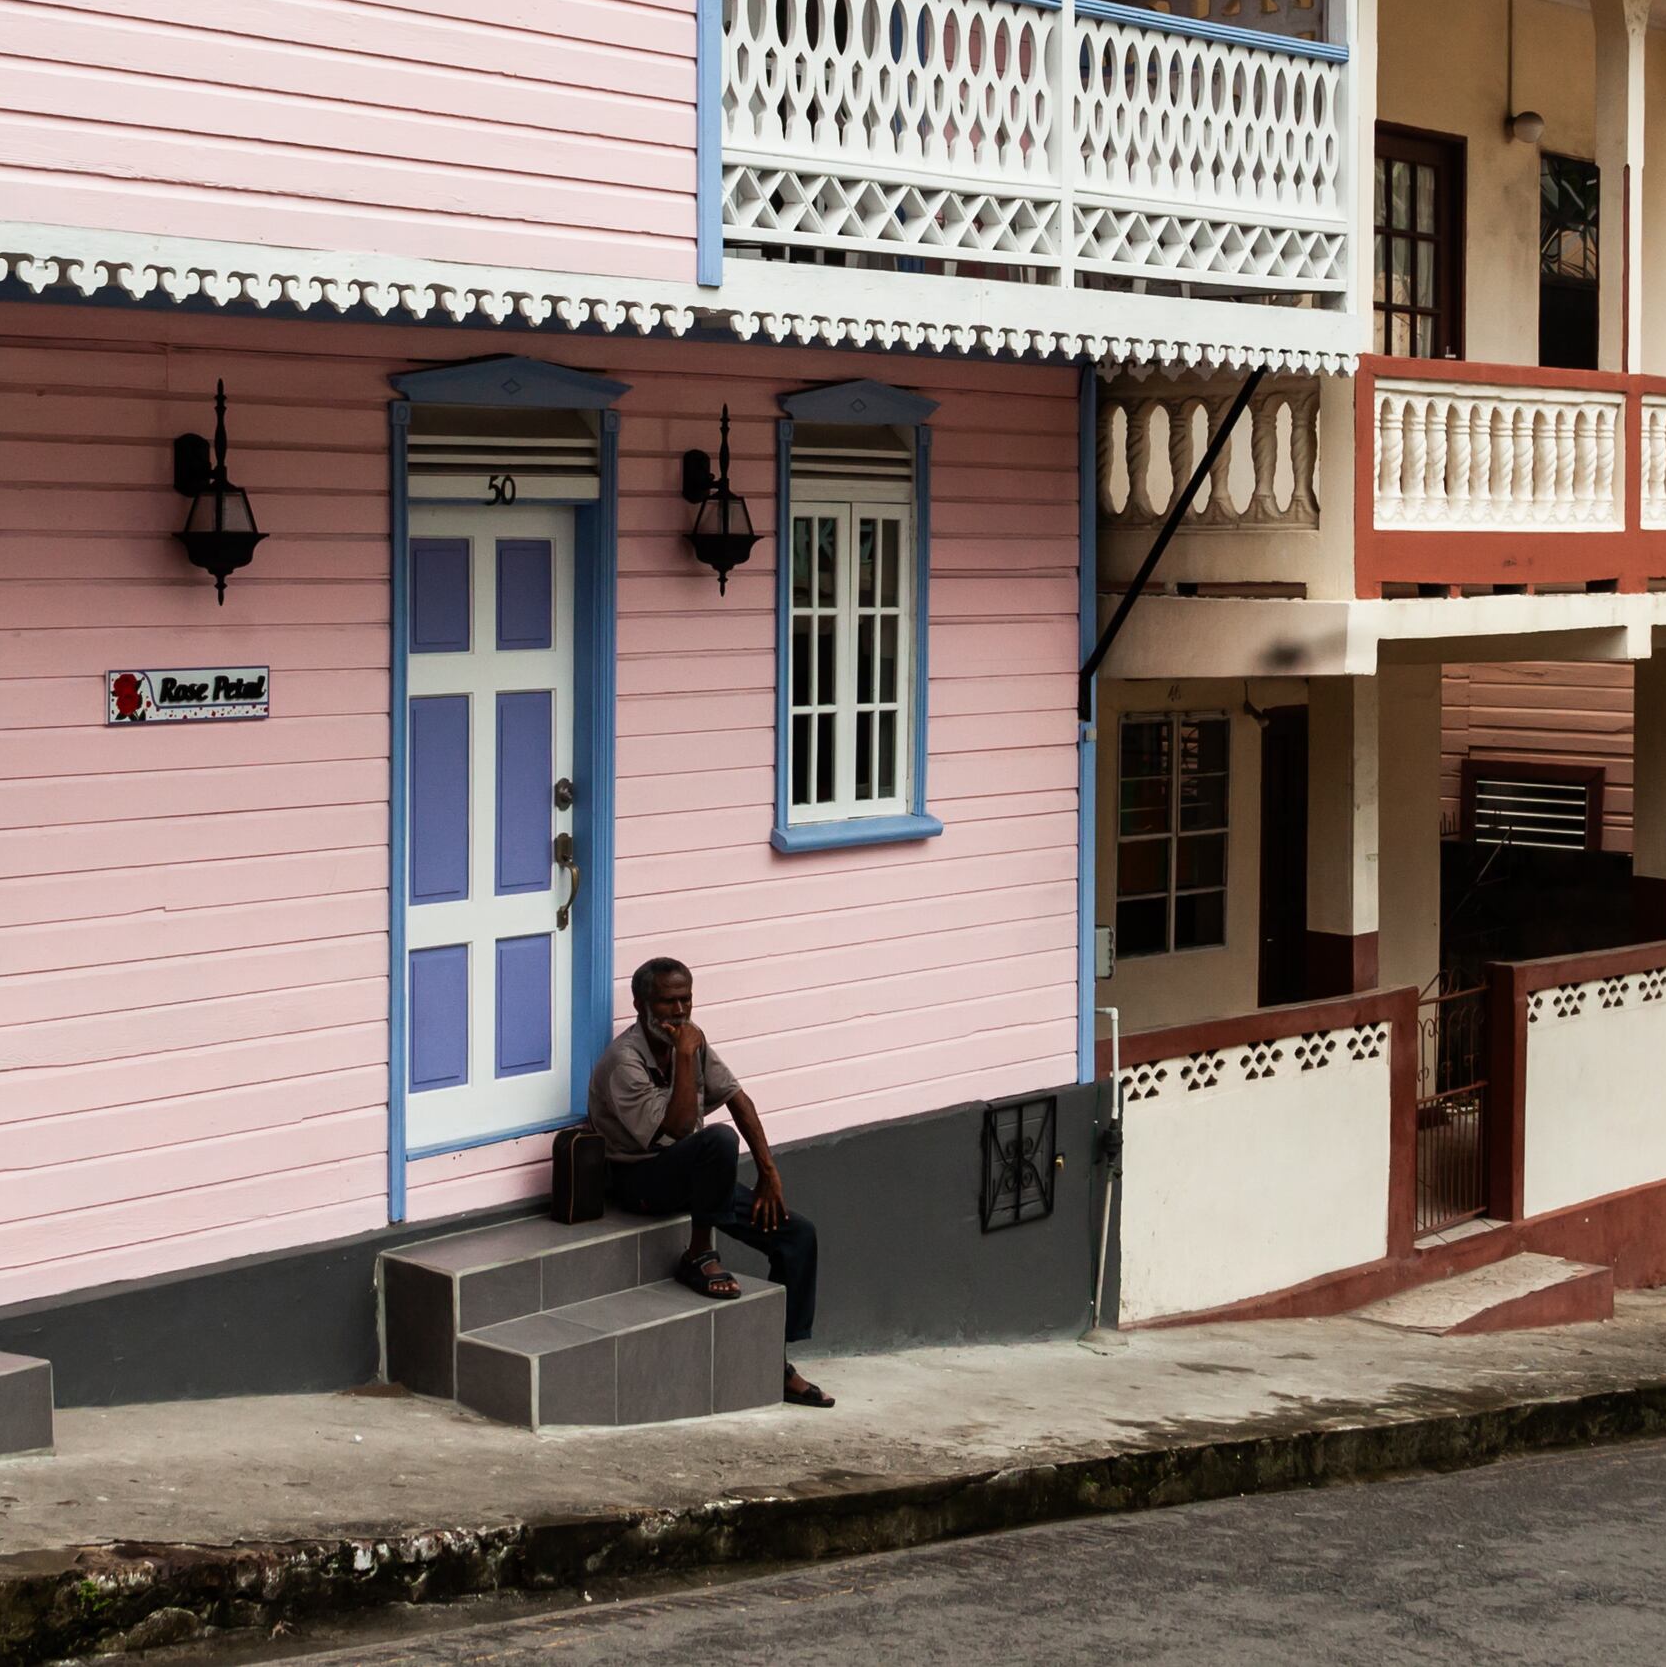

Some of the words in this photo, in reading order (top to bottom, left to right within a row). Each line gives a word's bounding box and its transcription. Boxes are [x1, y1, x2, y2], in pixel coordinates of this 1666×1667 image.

[485, 474, 516, 505] 50
[159, 676, 209, 703] Rose
[212, 675, 267, 701] Petal
